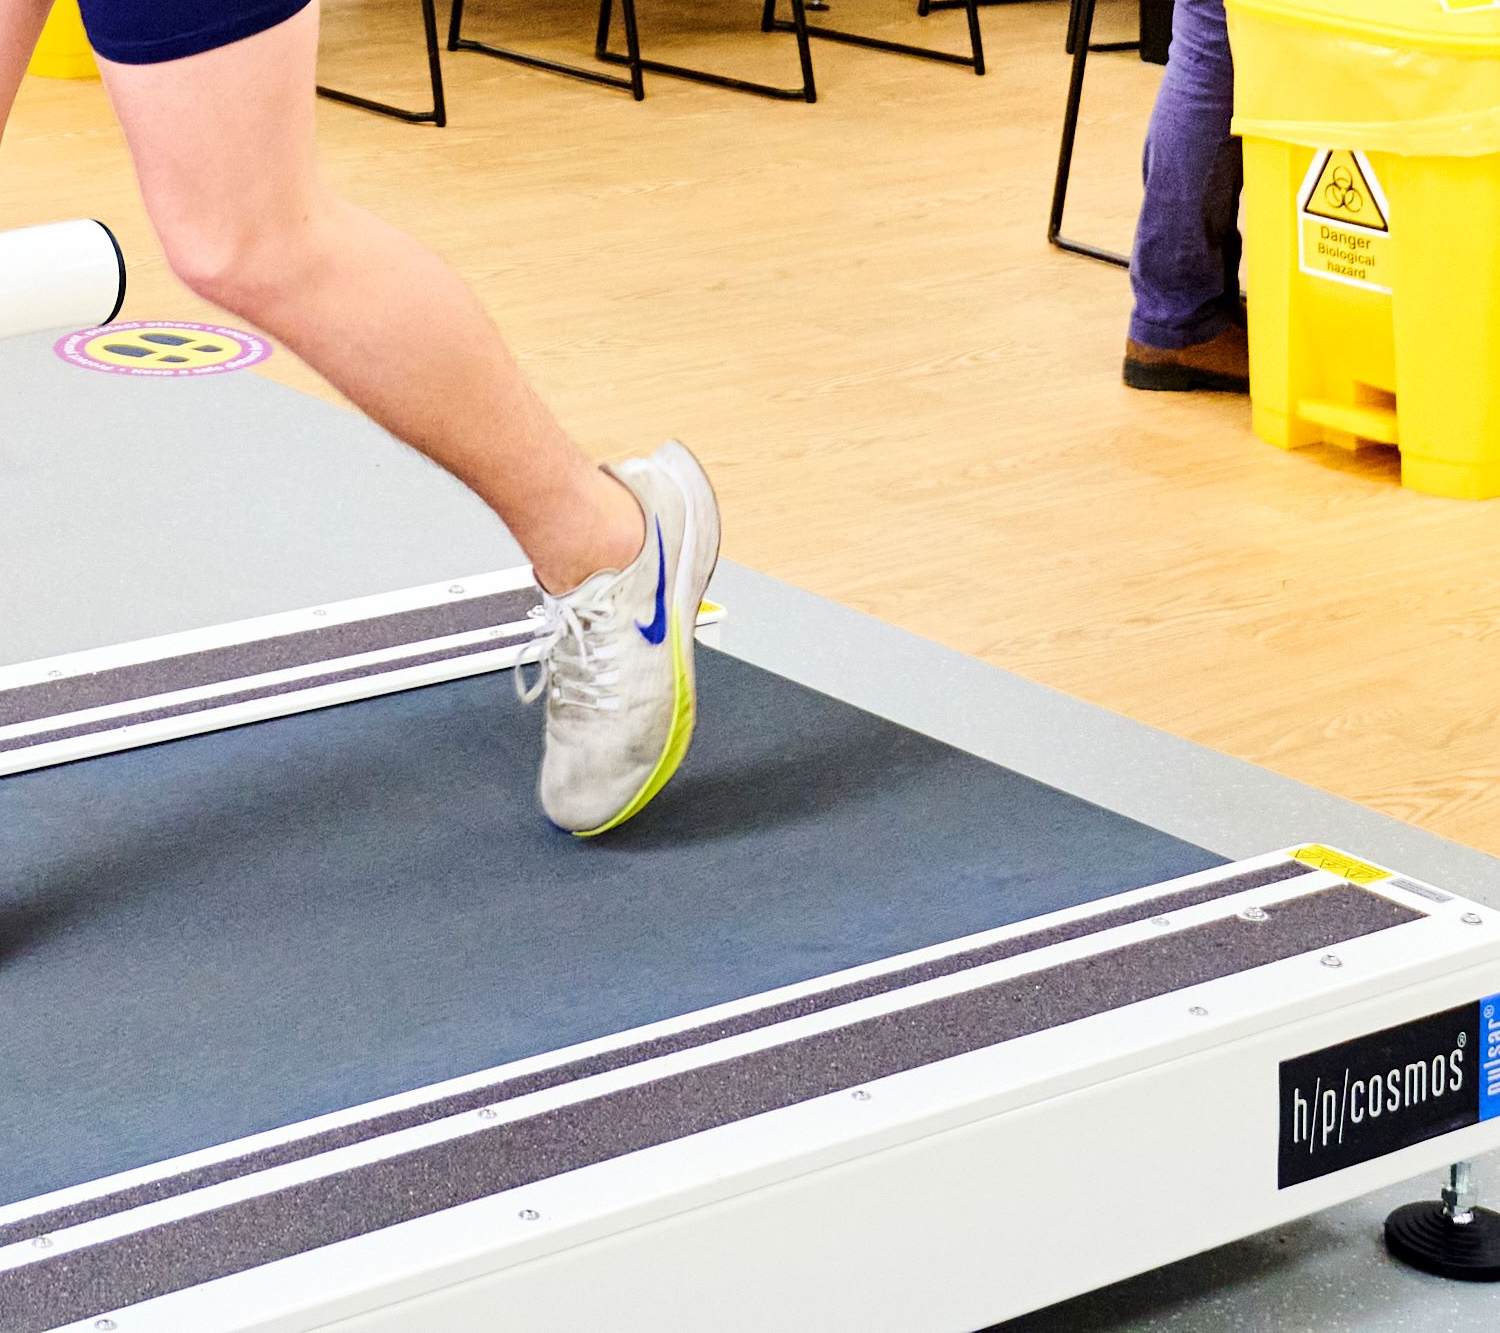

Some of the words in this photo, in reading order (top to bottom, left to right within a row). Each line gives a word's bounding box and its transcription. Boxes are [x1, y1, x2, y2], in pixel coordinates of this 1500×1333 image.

[1320, 225, 1371, 250] Danger
[1318, 242, 1375, 267] Biological
[1327, 260, 1366, 279] hazard
